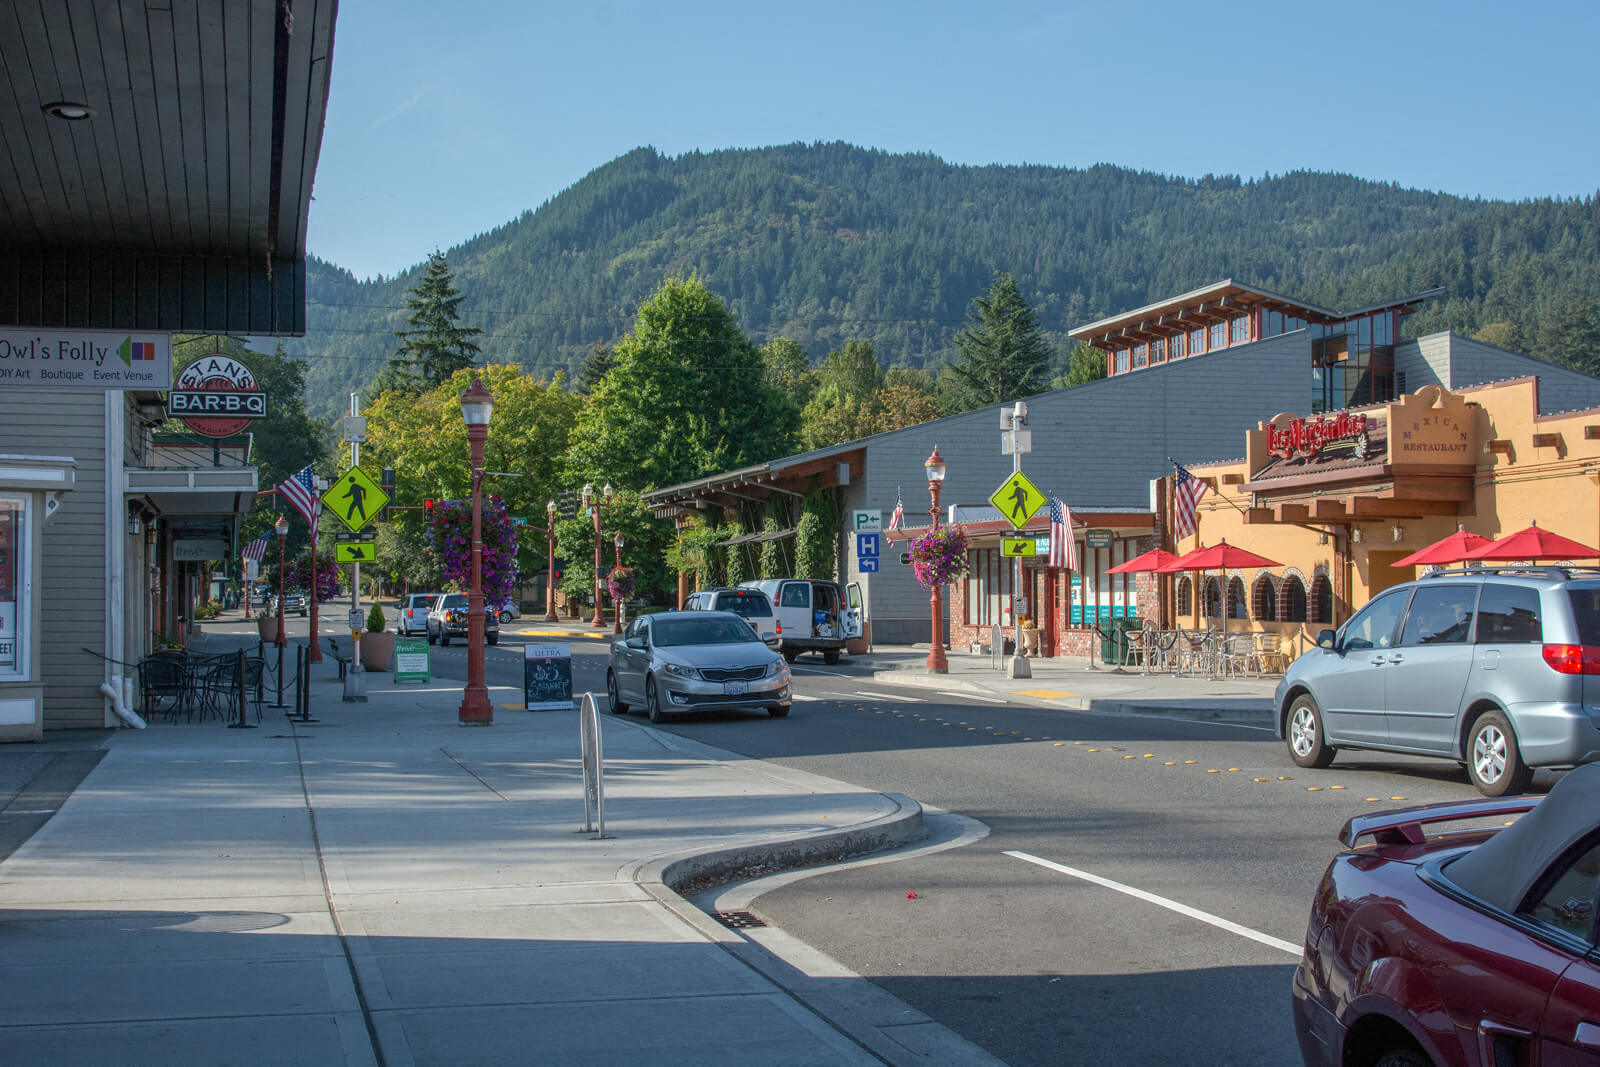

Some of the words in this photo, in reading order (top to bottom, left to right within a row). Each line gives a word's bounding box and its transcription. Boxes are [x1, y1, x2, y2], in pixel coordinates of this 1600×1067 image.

[0, 337, 50, 359] Owl's
[58, 340, 109, 366] Folly
[15, 369, 30, 379] Art
[41, 369, 84, 381] Boutique
[94, 369, 120, 380] Event
[124, 370, 153, 381] Venue
[182, 359, 251, 389] STAN'S
[173, 394, 263, 413] BAR-B-Q
[1288, 412, 1366, 457] Margaritas
[1402, 416, 1467, 440] MEXICAN
[1403, 442, 1467, 452] RESTAURANT
[861, 536, 876, 554] H
